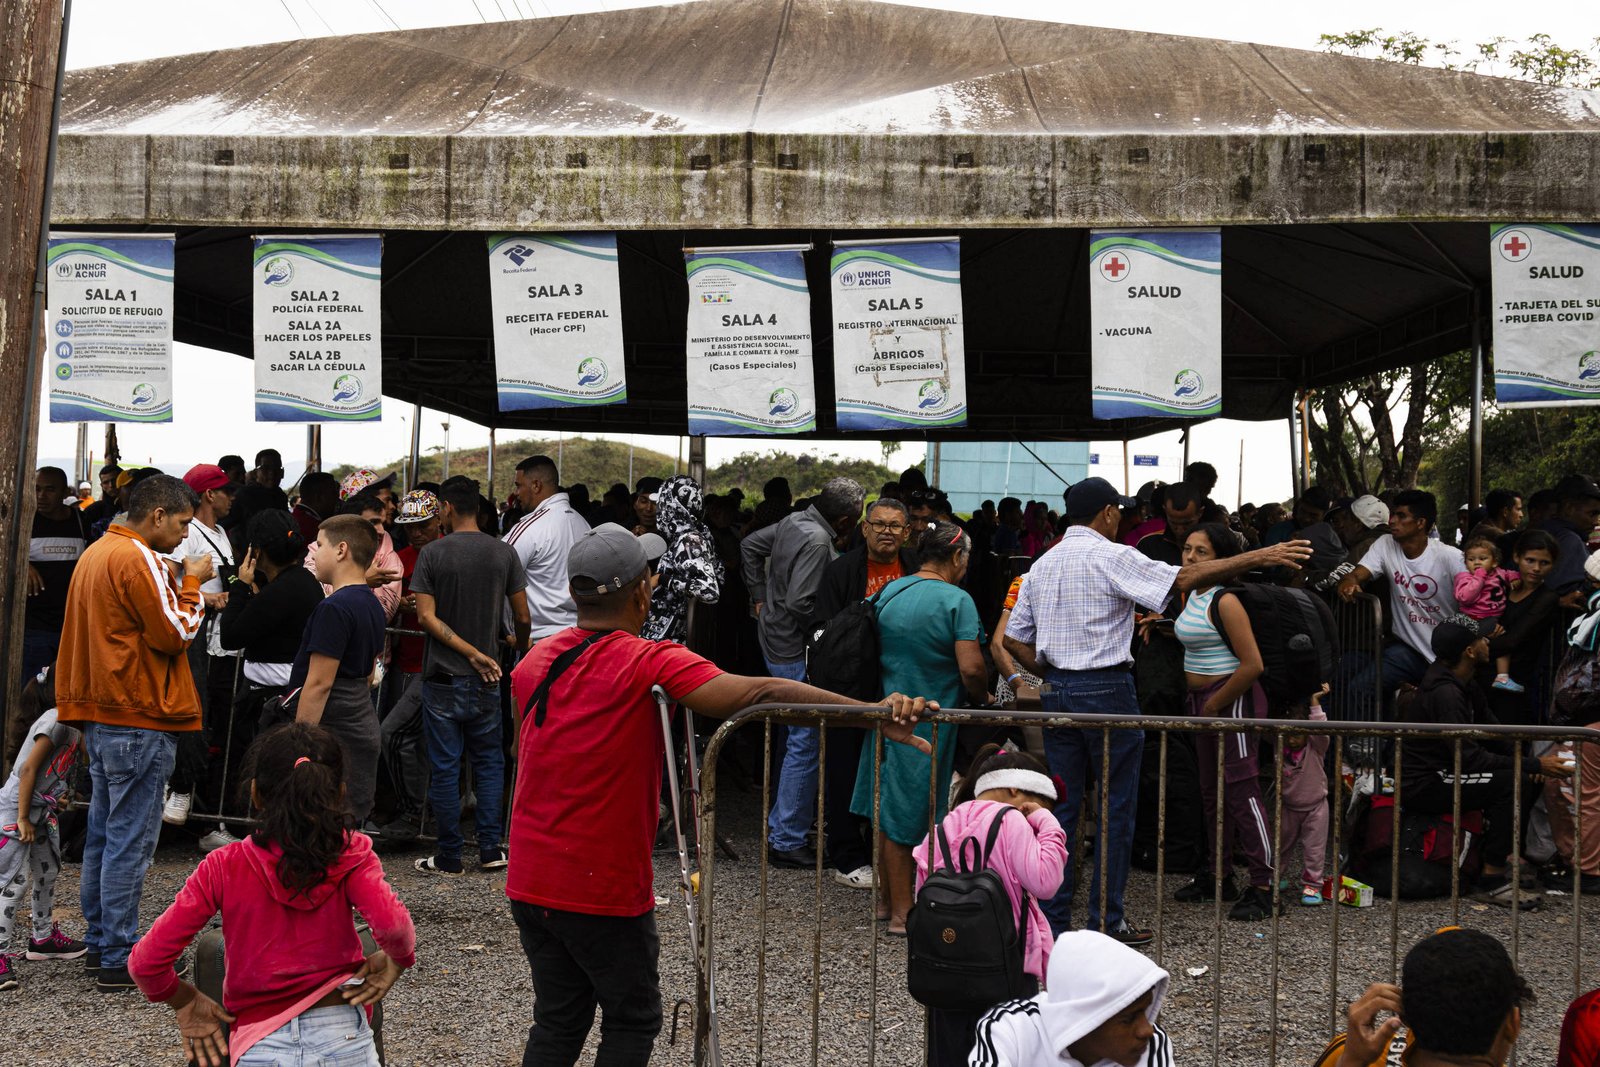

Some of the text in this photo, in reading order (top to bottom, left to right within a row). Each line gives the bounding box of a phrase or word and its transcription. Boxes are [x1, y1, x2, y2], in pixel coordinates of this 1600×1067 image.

[1529, 266, 1584, 279] SALUD
[86, 289, 136, 301] SALA 1
[291, 291, 340, 301] SALA 2
[528, 284, 583, 298] SALA 3
[1128, 286, 1181, 298] SALUD
[273, 304, 314, 313] POLICÍA
[868, 298, 923, 311] SALA 5
[1505, 300, 1557, 310] TARJETA
[1561, 300, 1582, 308] DEL
[62, 307, 106, 315] SOLICITUD
[124, 308, 163, 316] REFUGIO
[506, 310, 608, 324] RECEITA FEDERAL
[722, 314, 777, 327] SALA 4
[1506, 314, 1553, 323] PRUEBA
[1557, 313, 1593, 321] COVID
[288, 321, 341, 330] SALA 2A
[838, 317, 957, 329] REGISTRO NTERNACIONAL
[530, 324, 586, 336] (Hacer CPF)
[1105, 326, 1152, 336] VACUNA
[718, 341, 762, 349] ASSISTÊNCIA
[290, 351, 341, 360] SALA 2B
[873, 350, 924, 360] ABRIGOS
[324, 362, 365, 371] CÉDULA
[710, 362, 796, 372] (Casos Especiales)
[855, 362, 944, 373] (Casos Especiales)
